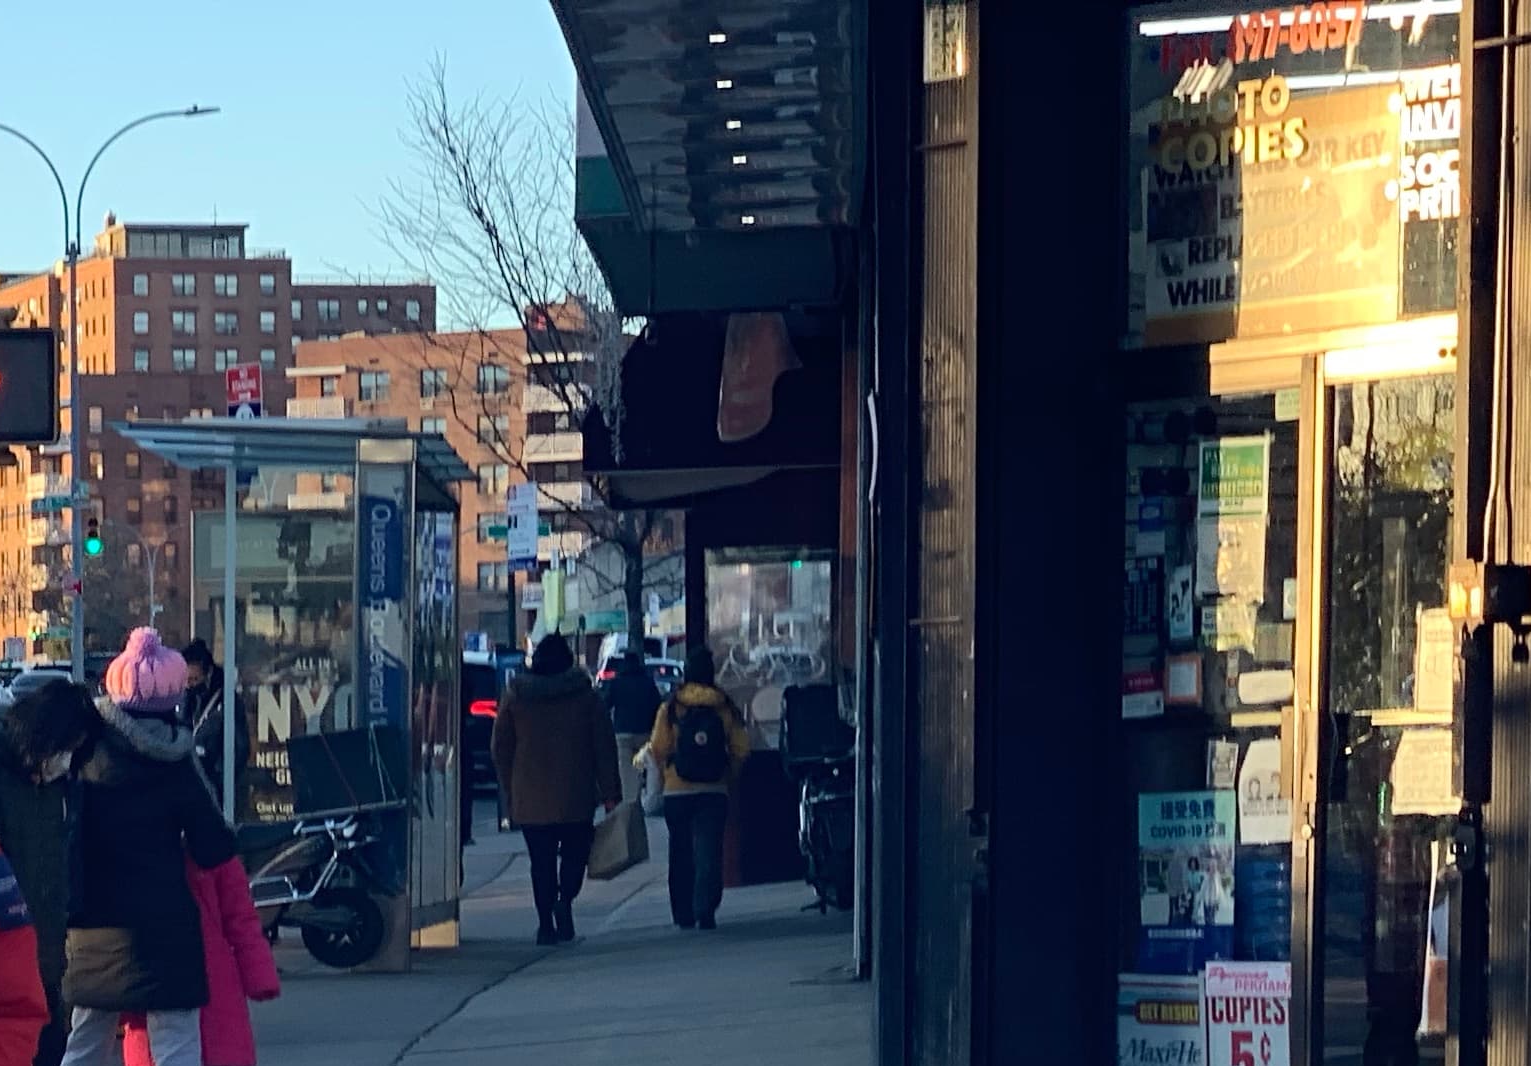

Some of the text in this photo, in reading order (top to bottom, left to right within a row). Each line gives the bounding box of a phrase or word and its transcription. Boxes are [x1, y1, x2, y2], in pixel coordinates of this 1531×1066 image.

[1161, 75, 1290, 127] PHOTO
[1160, 117, 1306, 173] COPIES
[1346, 130, 1387, 160] KEY
[1167, 274, 1236, 307] WHILE
[371, 503, 392, 593] Queens
[370, 597, 390, 713] Boevard
[1150, 824, 1203, 839] COVID-19
[1211, 996, 1286, 1025] COPIES
